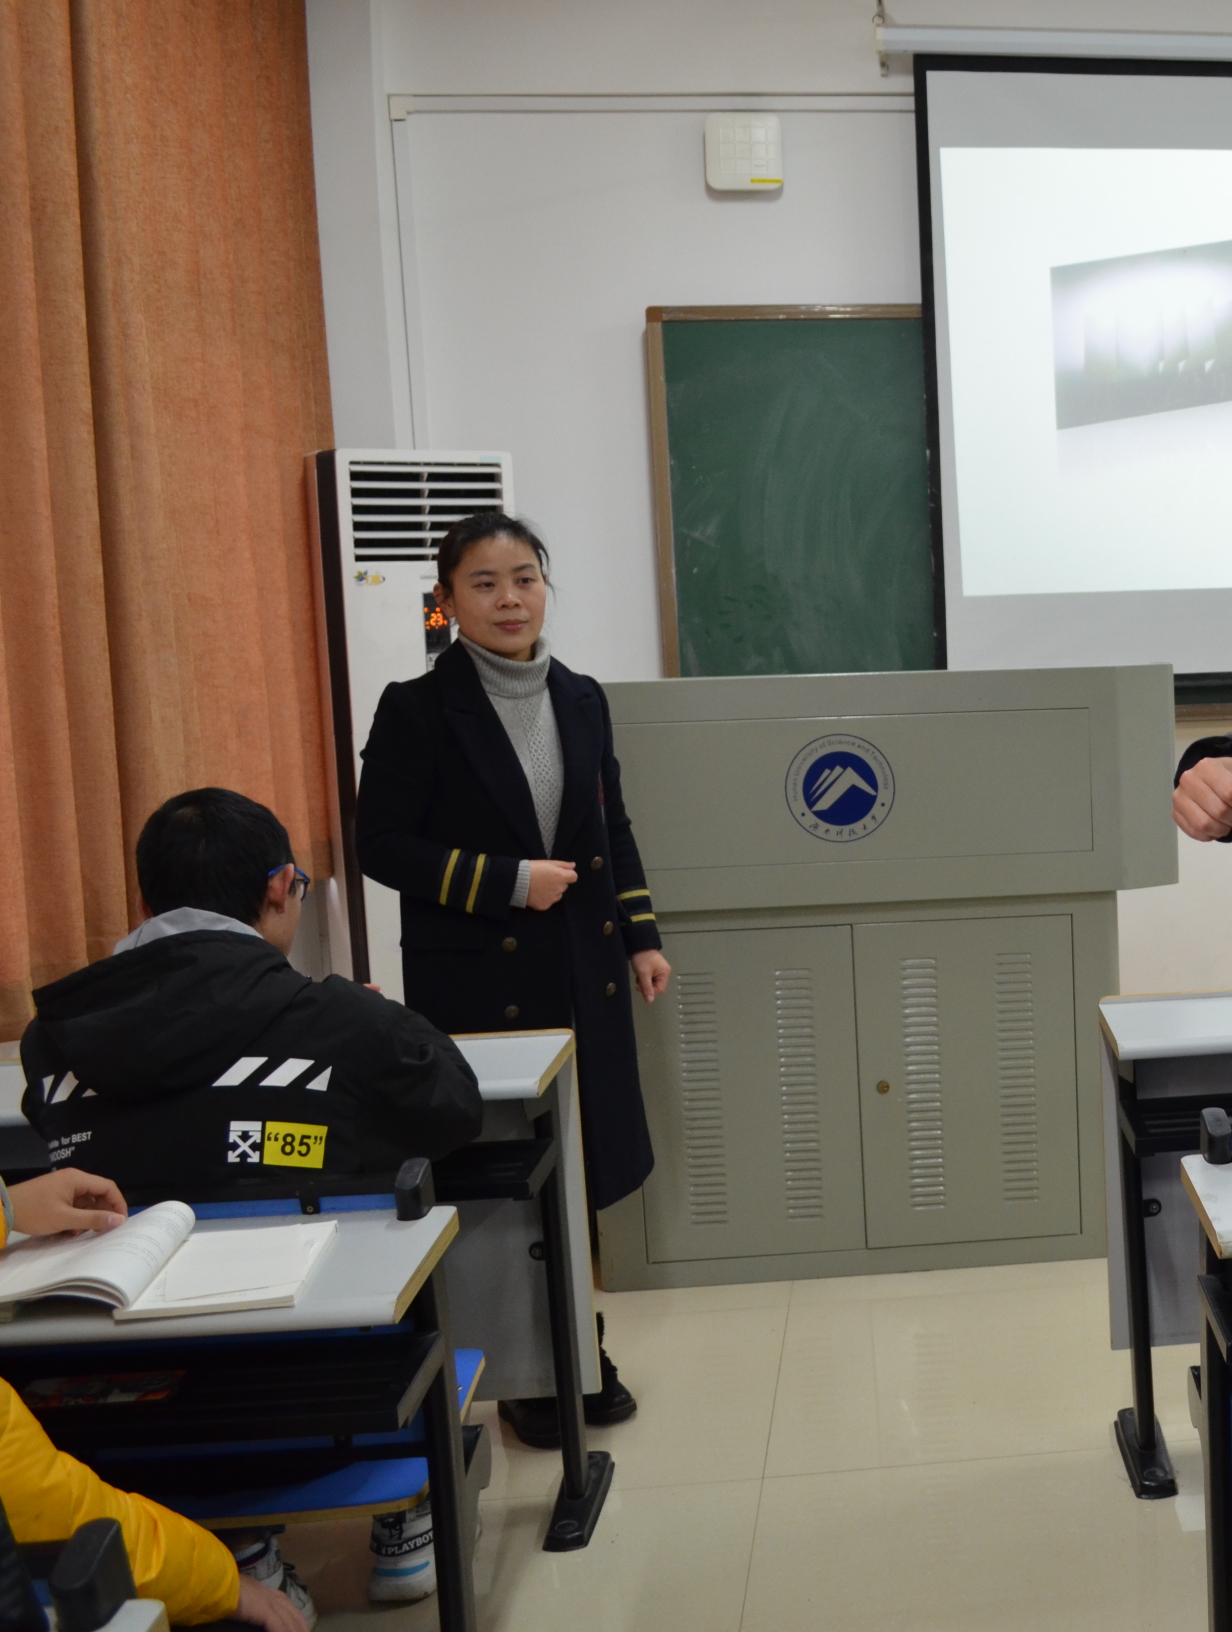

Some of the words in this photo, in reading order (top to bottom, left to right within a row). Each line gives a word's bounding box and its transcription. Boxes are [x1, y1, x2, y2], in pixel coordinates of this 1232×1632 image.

[827, 740, 856, 748] Science
[856, 742, 871, 754] and
[61, 1136, 71, 1145] for
[71, 1131, 92, 1143] BEST
[387, 1530, 434, 1555] PLAYBOY
